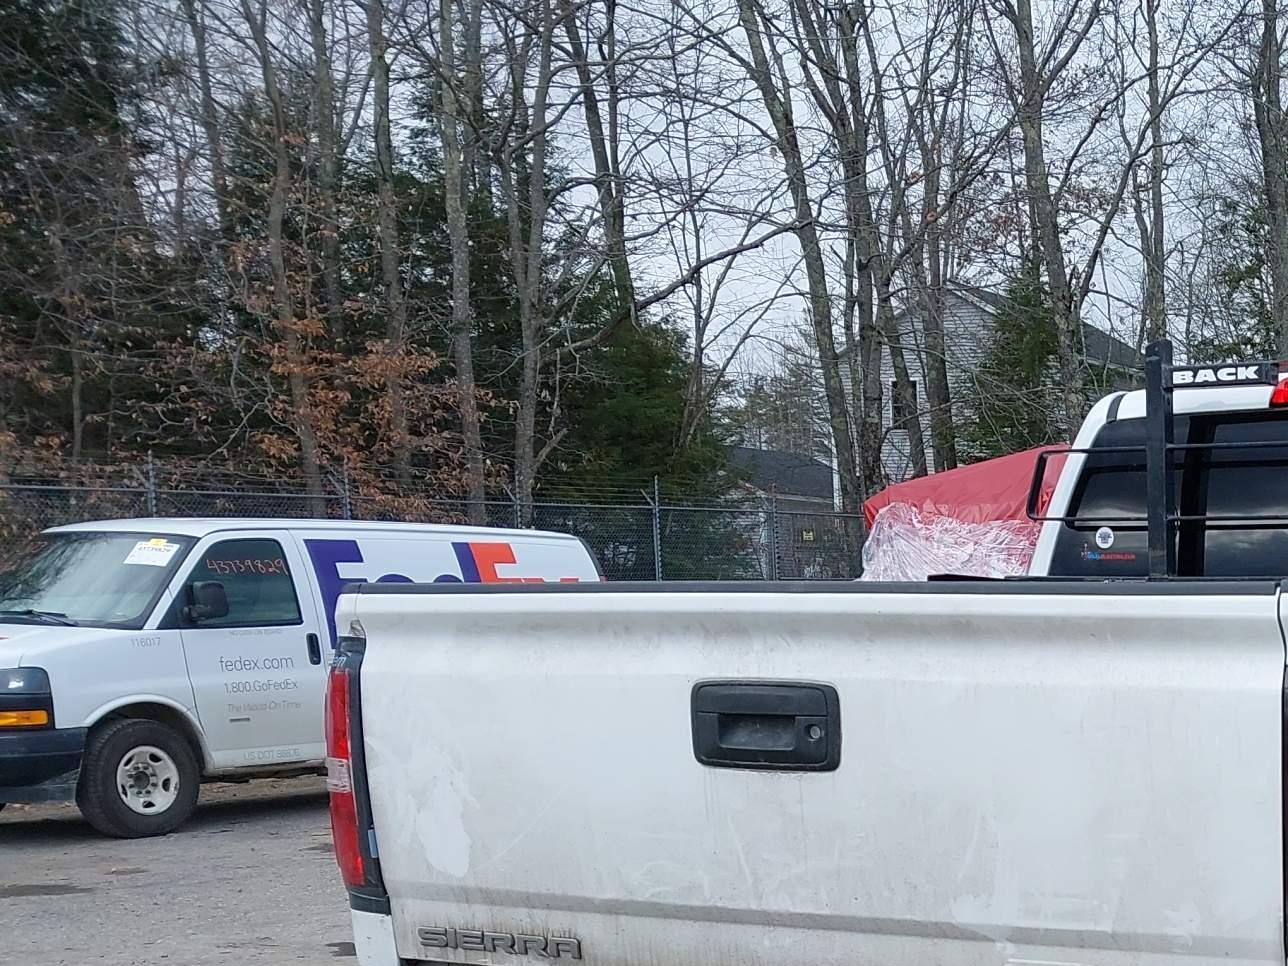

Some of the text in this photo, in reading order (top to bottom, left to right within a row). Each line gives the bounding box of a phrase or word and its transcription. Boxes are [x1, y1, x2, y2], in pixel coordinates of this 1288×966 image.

[1172, 366, 1260, 385] BACK
[206, 558, 288, 575] 43739829
[218, 655, 294, 673] fedex.com
[417, 926, 583, 960] SIERRA
